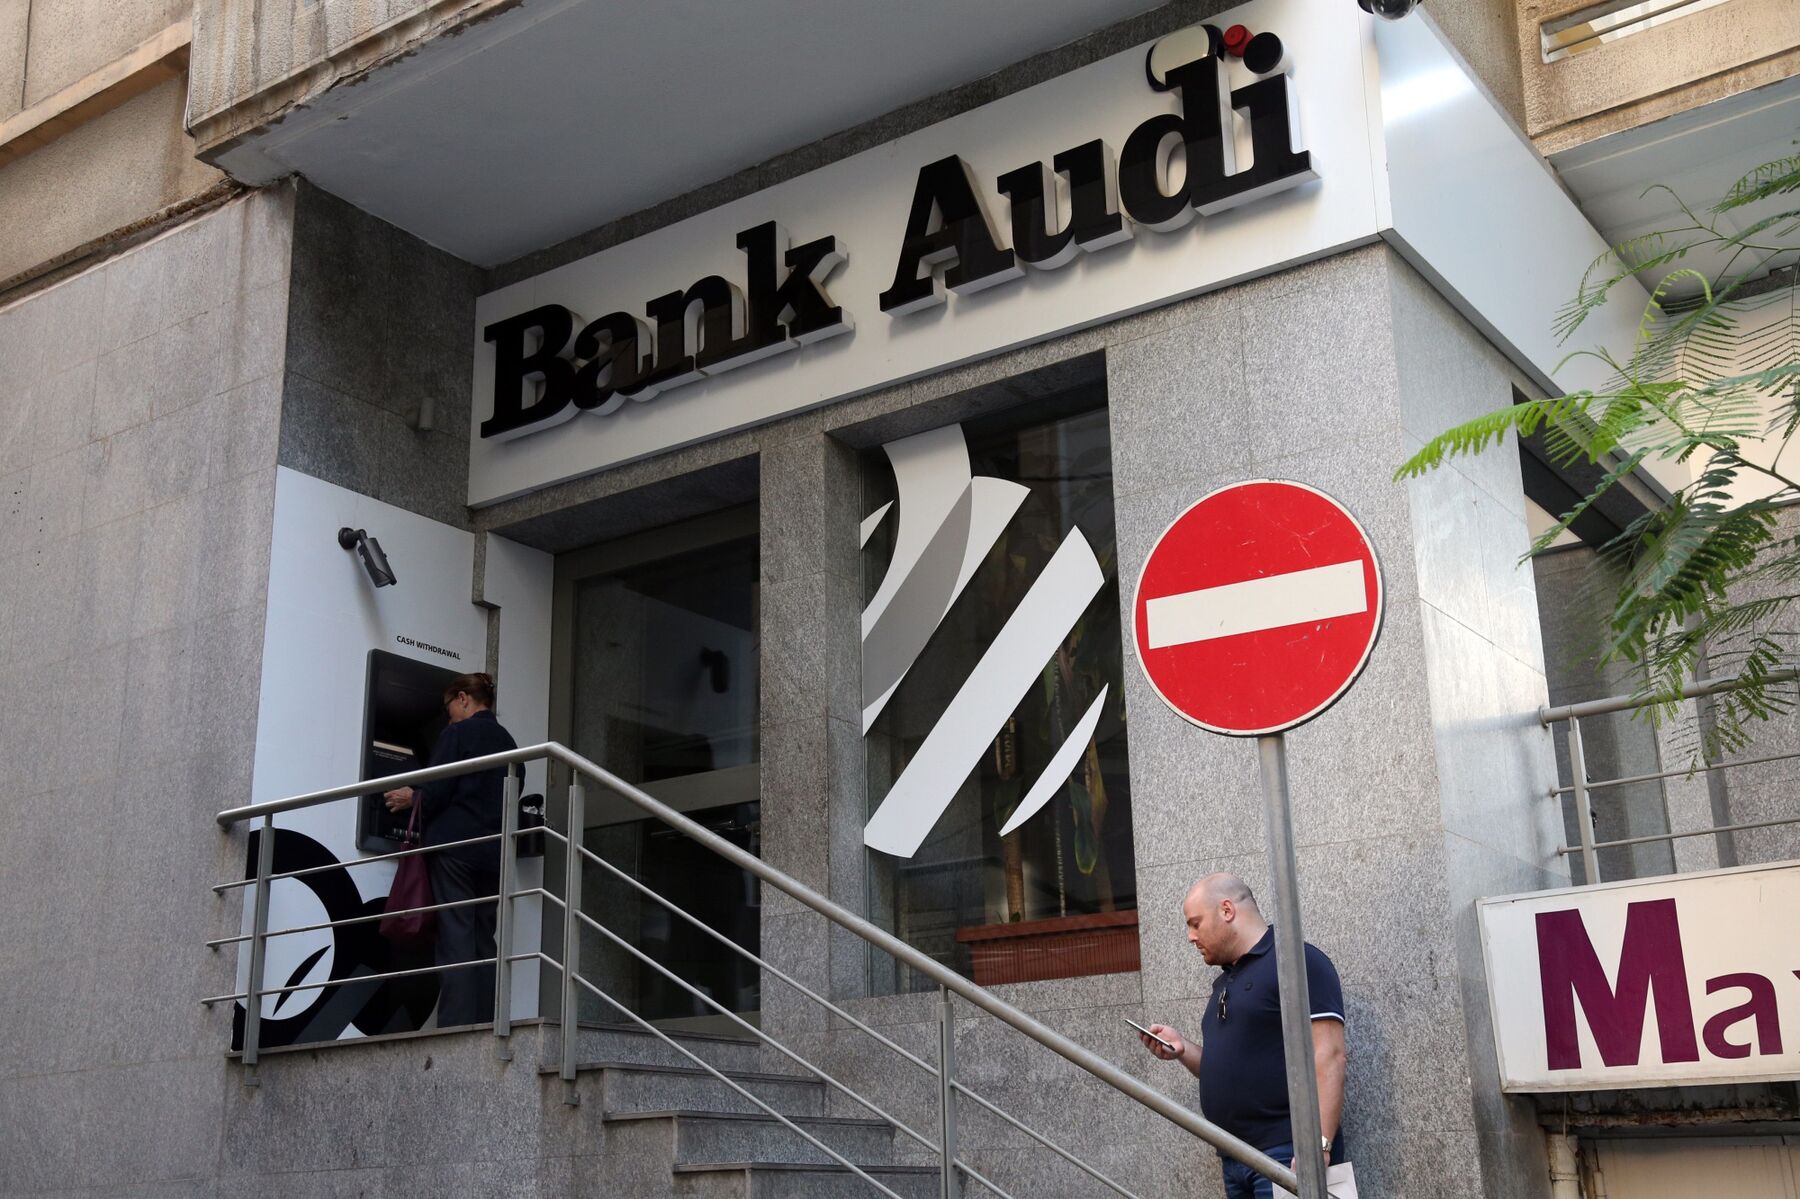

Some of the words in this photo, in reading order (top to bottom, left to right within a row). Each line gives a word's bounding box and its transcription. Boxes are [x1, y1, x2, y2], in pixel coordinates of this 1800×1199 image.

[480, 219, 848, 439] Bank
[880, 25, 1315, 315] Audi
[396, 635, 415, 647] CASH
[416, 641, 461, 660] WITHDRAWAL
[1535, 897, 1800, 1071] Ma
